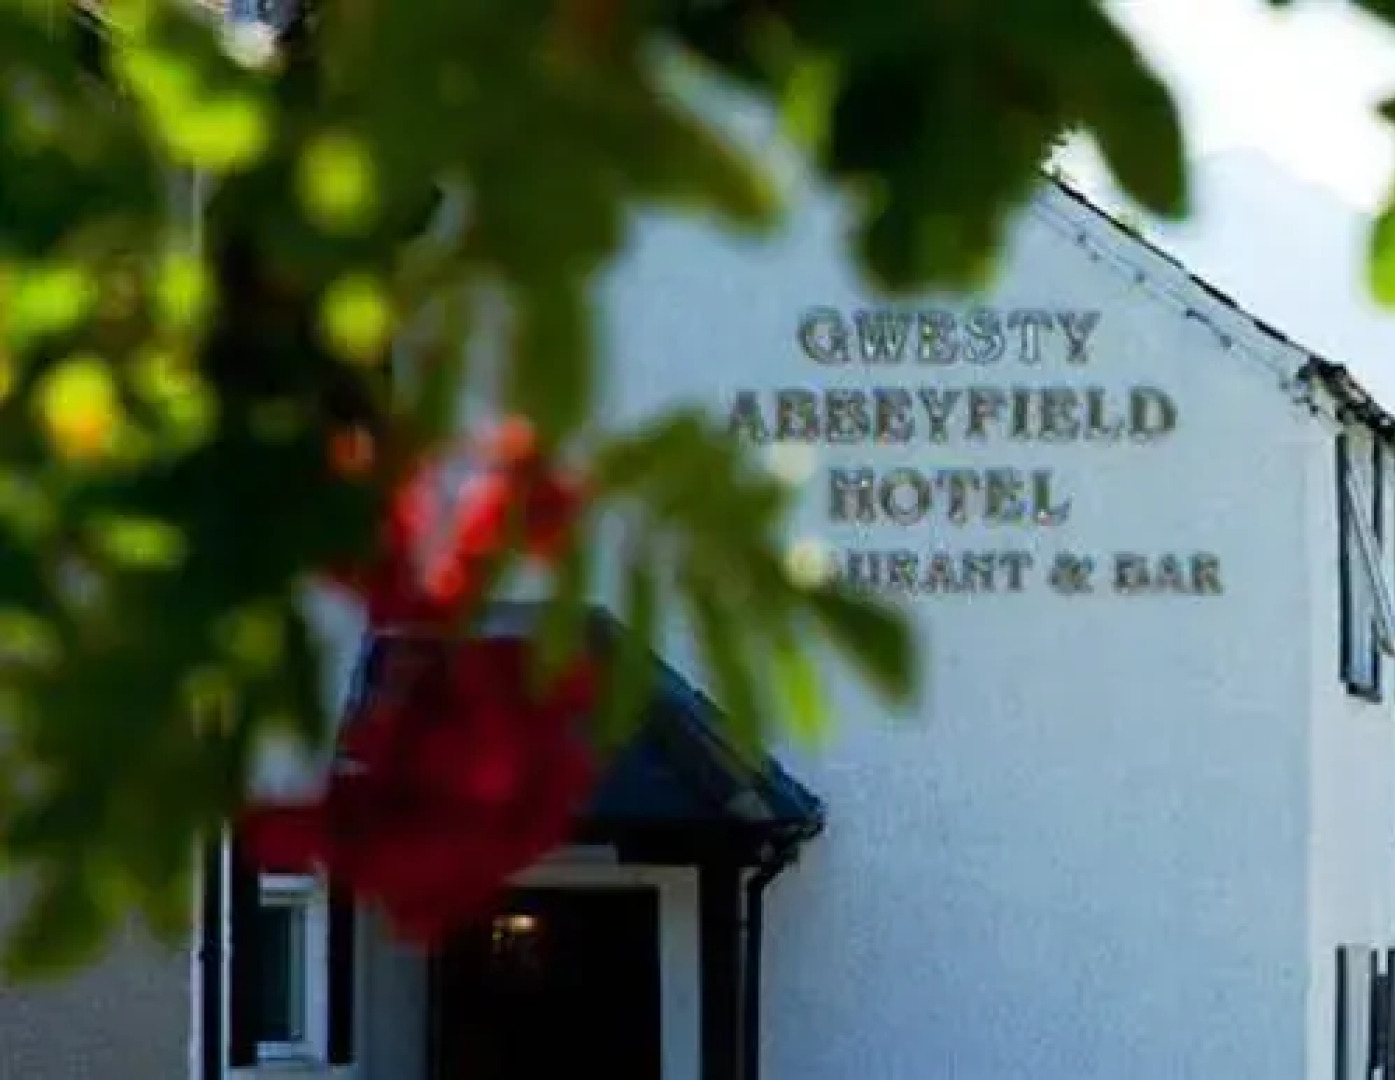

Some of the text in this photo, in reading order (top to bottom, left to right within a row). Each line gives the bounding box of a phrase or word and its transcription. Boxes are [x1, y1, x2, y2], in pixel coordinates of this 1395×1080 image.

[797, 308, 1099, 364] GWESTY
[728, 387, 1178, 444] ABBEYFIELD
[828, 467, 1071, 526] HOTEL
[828, 549, 1225, 596] URANT & BAR
